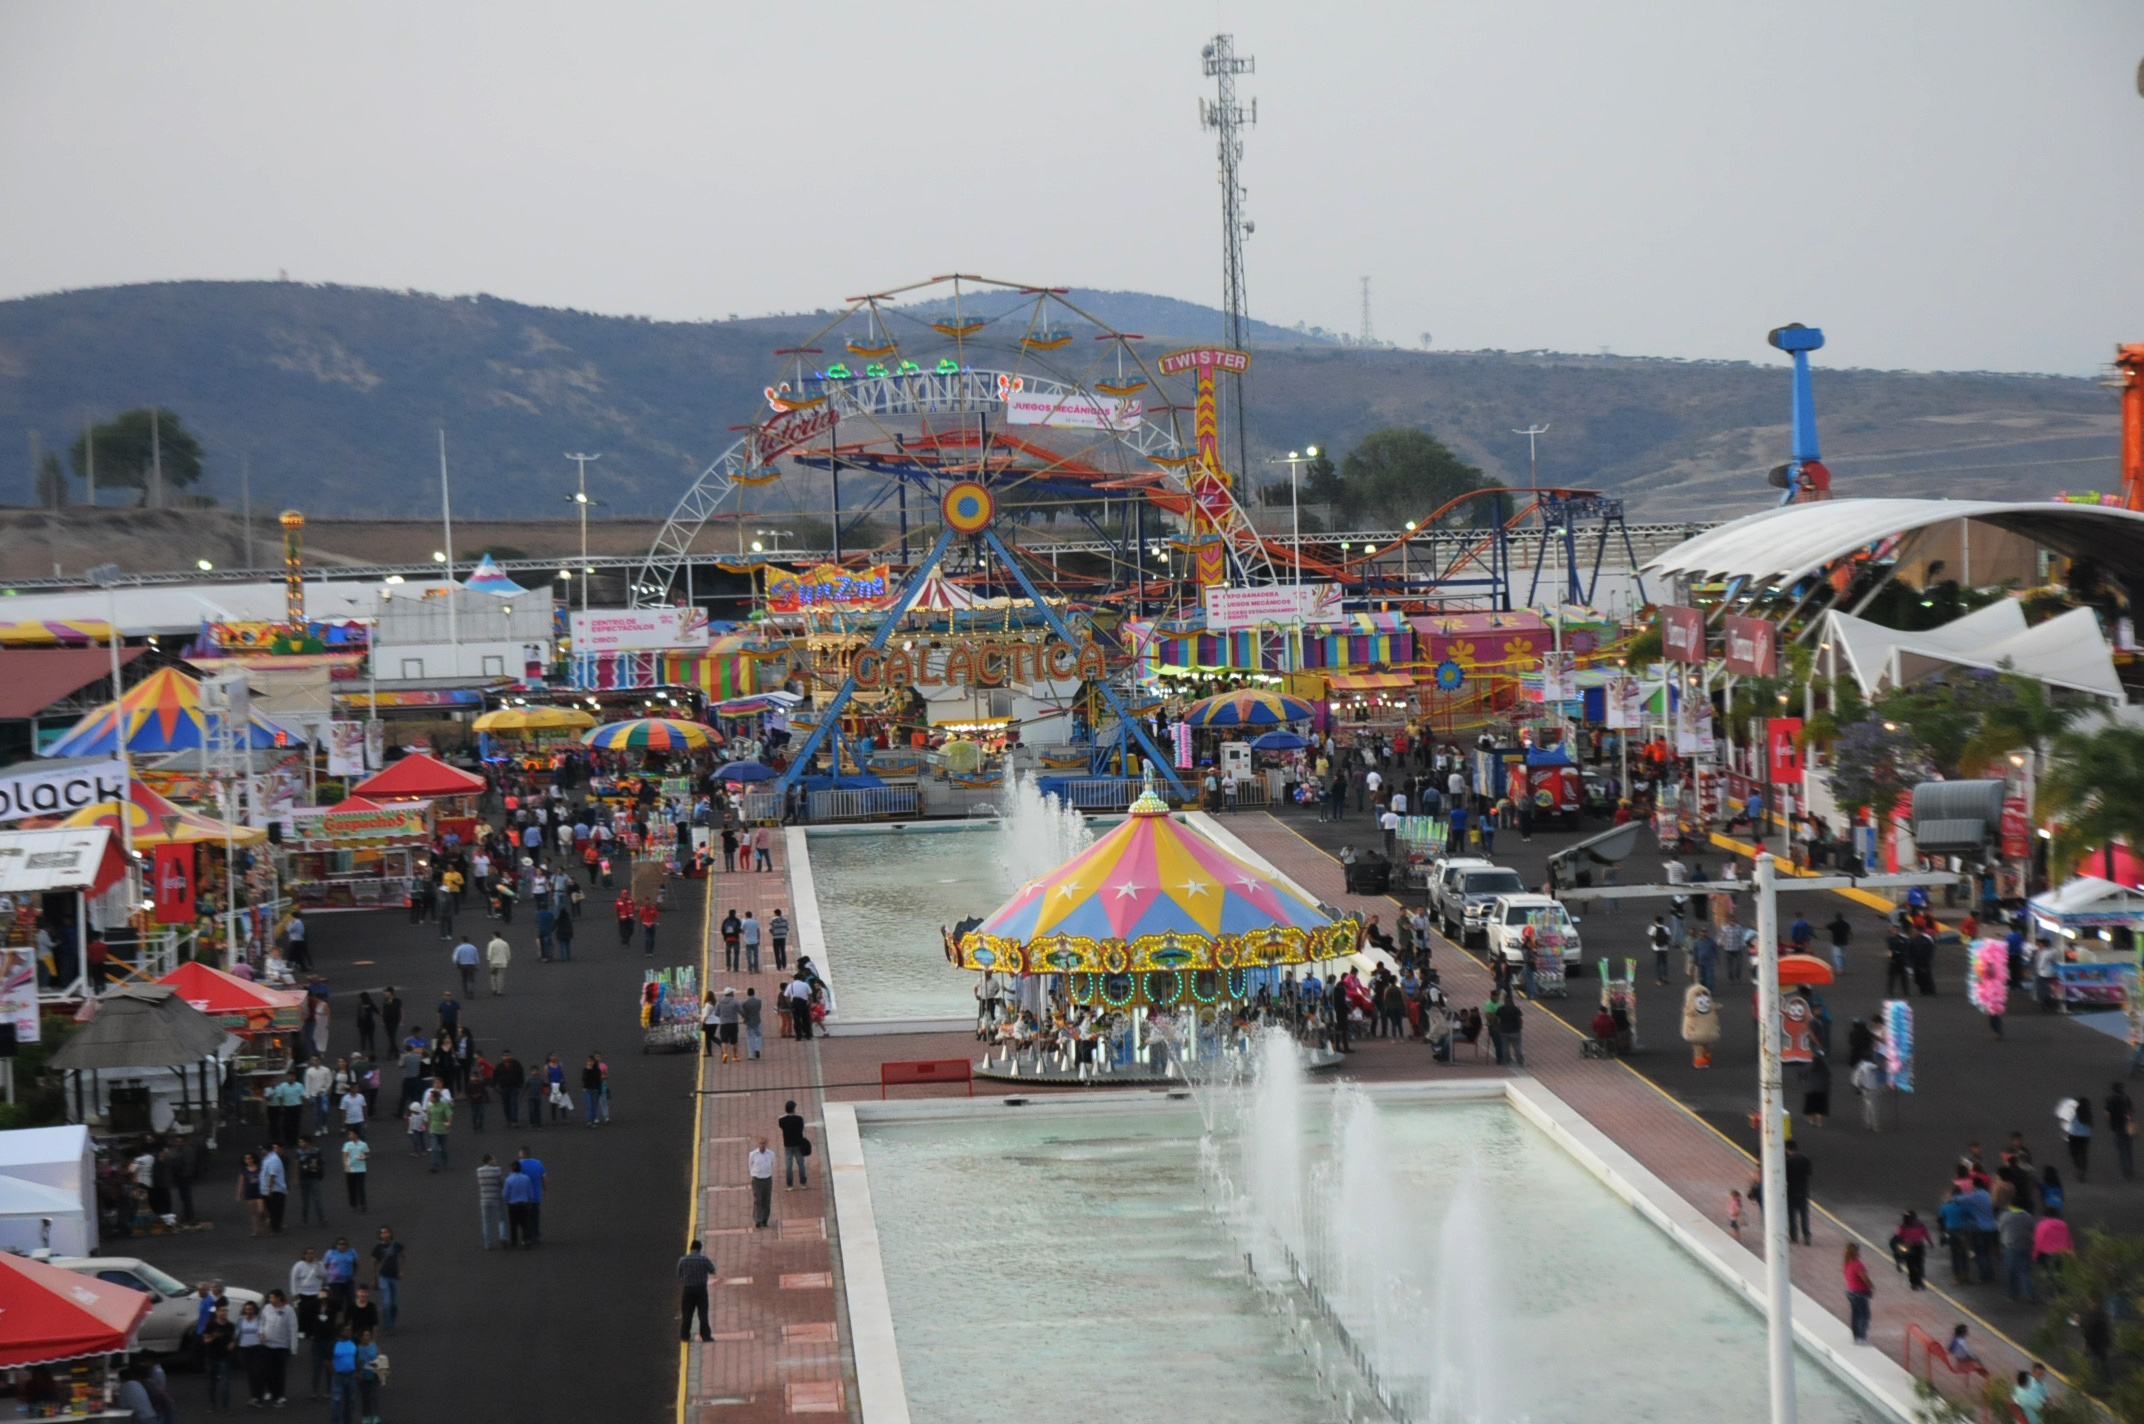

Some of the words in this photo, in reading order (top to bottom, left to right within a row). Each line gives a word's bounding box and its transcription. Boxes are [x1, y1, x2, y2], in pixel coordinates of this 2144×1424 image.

[1164, 350, 1246, 371] TWISTER
[1013, 402, 1051, 412] JUEGOS
[1054, 403, 1111, 416] MECÁNICOS
[1223, 601, 1250, 609] UEGOS
[852, 640, 1107, 688] GALACTICA
